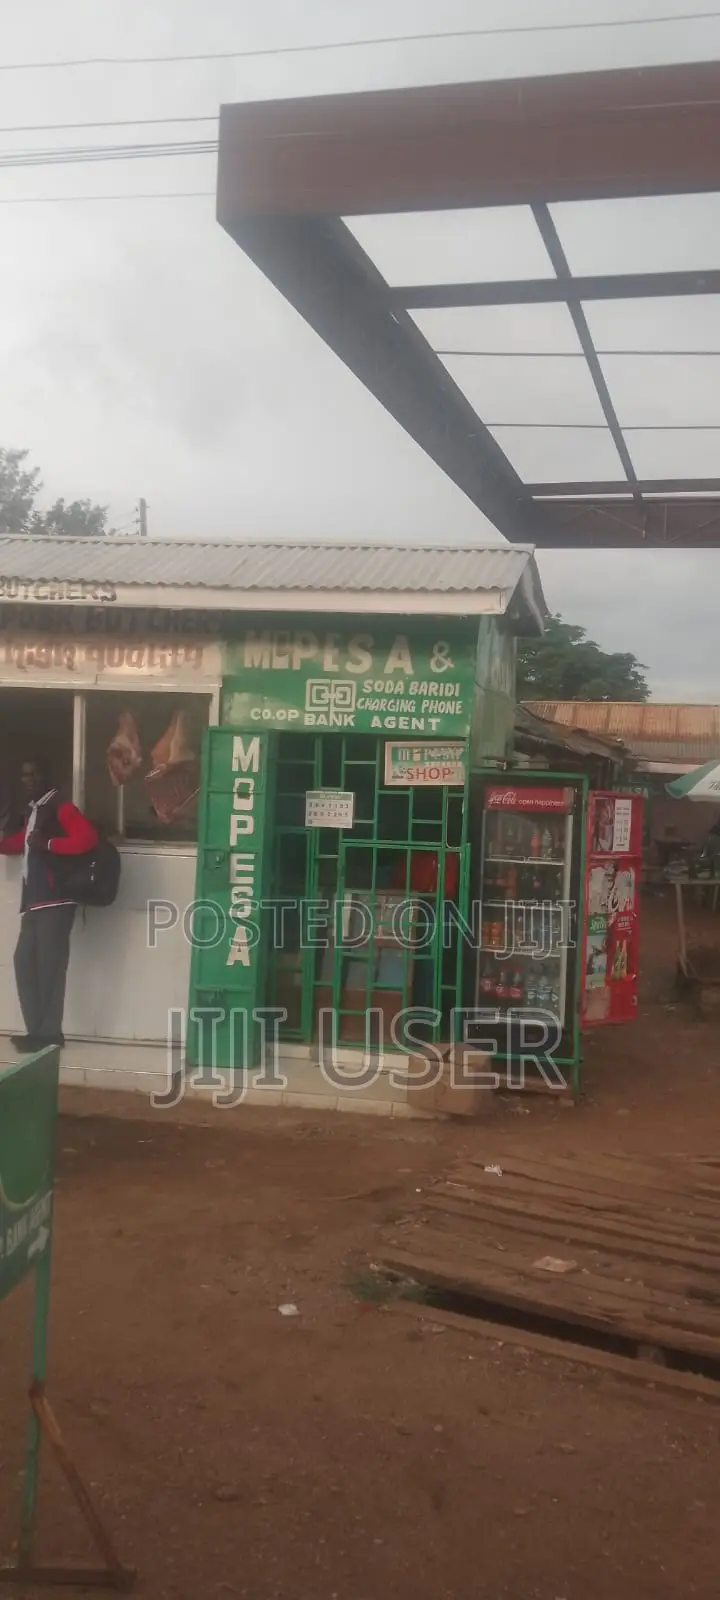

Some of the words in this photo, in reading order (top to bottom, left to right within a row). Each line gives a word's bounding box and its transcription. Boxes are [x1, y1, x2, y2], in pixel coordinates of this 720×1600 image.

[430, 640, 454, 673] &
[362, 679, 404, 695] SODA
[409, 681, 460, 697] BARIDI
[356, 698, 416, 713] CHARGING
[421, 699, 463, 715] PHONE
[304, 713, 355, 727] BANK
[370, 716, 441, 731] AGENT
[406, 767, 451, 780] SHOP
